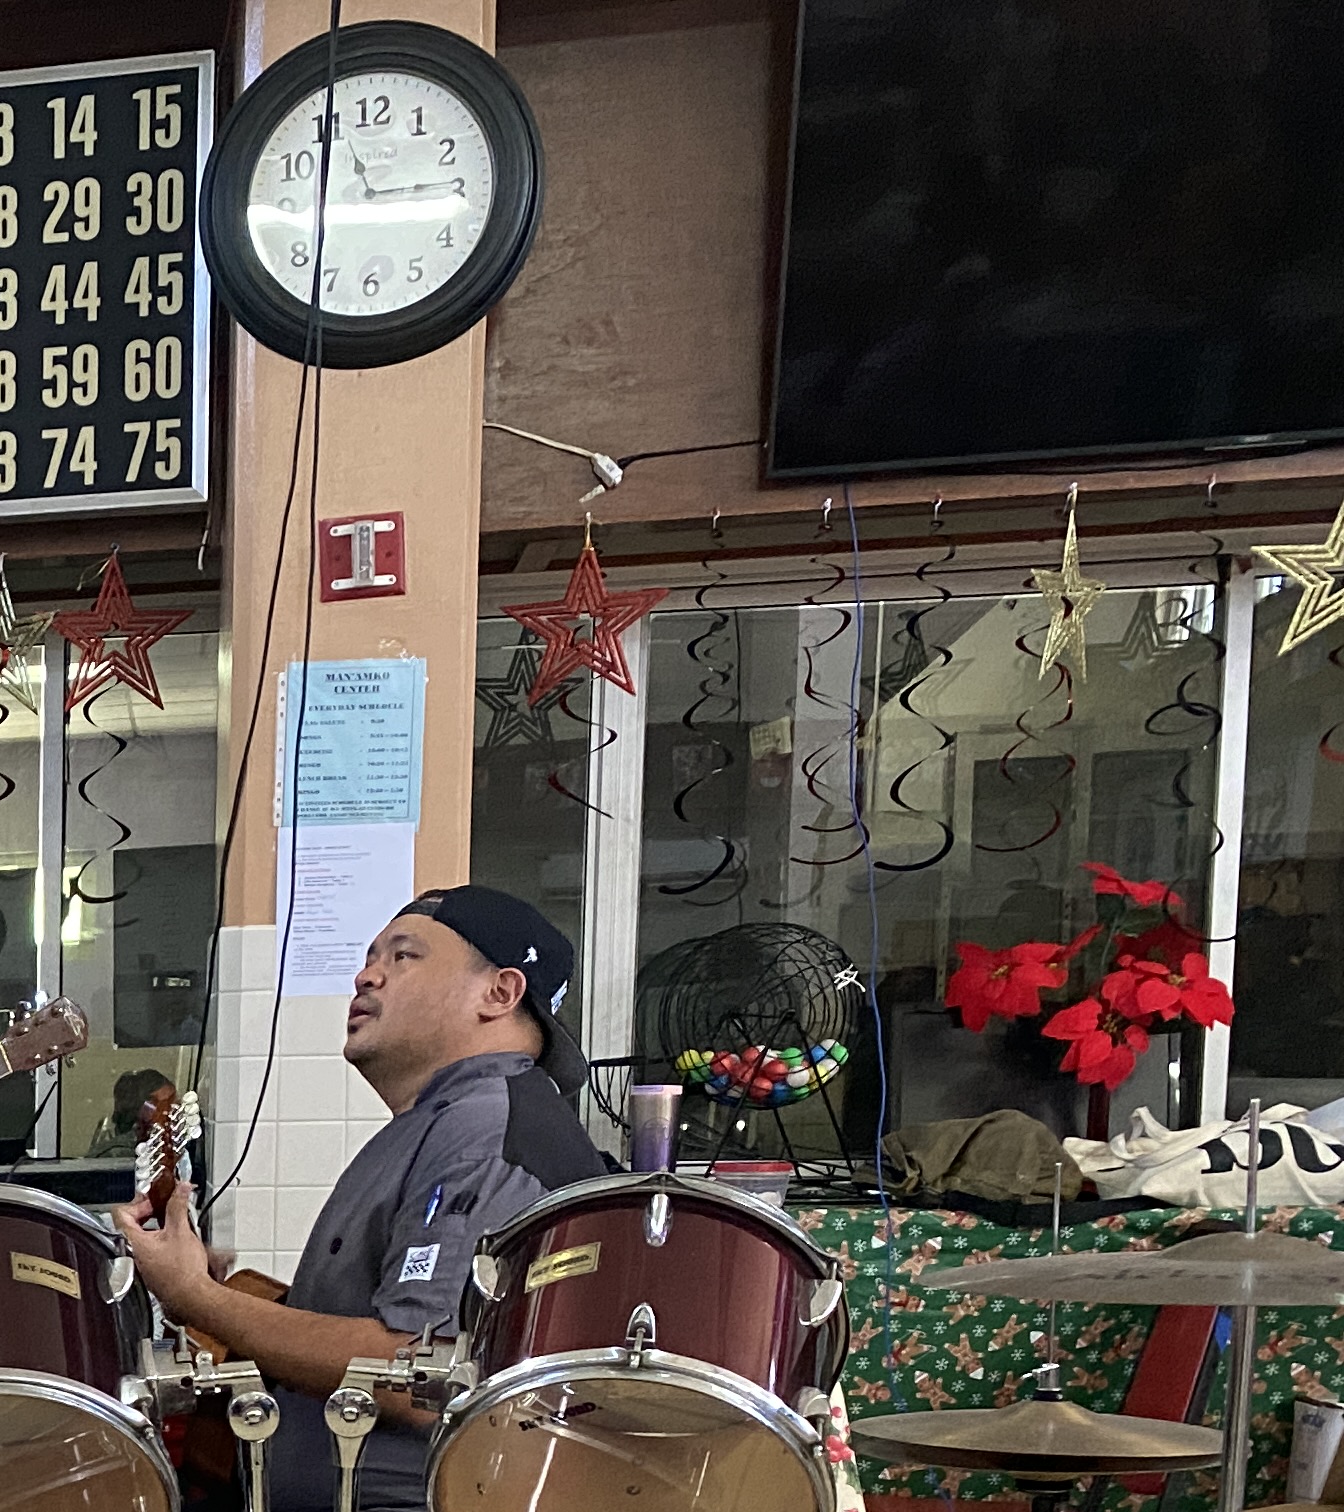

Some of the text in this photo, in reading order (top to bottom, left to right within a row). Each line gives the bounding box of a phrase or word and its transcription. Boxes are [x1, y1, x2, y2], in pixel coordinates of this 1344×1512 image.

[46, 94, 98, 160] 14
[132, 84, 182, 151] 15
[312, 111, 344, 144] 11
[355, 95, 391, 128] 12
[410, 106, 427, 136] 1
[280, 150, 315, 183] 10
[438, 138, 456, 166] 2
[42, 177, 101, 244] 29
[125, 168, 184, 236] 30
[436, 223, 454, 249] 4
[290, 241, 310, 268] 8
[406, 256, 424, 283] 5
[40, 261, 101, 325] 44
[124, 252, 184, 317] 45
[323, 267, 341, 293] 7
[362, 272, 380, 297] 6
[41, 343, 99, 409] 59
[124, 336, 182, 402] 60
[41, 425, 98, 489] 74
[123, 418, 182, 483] 75
